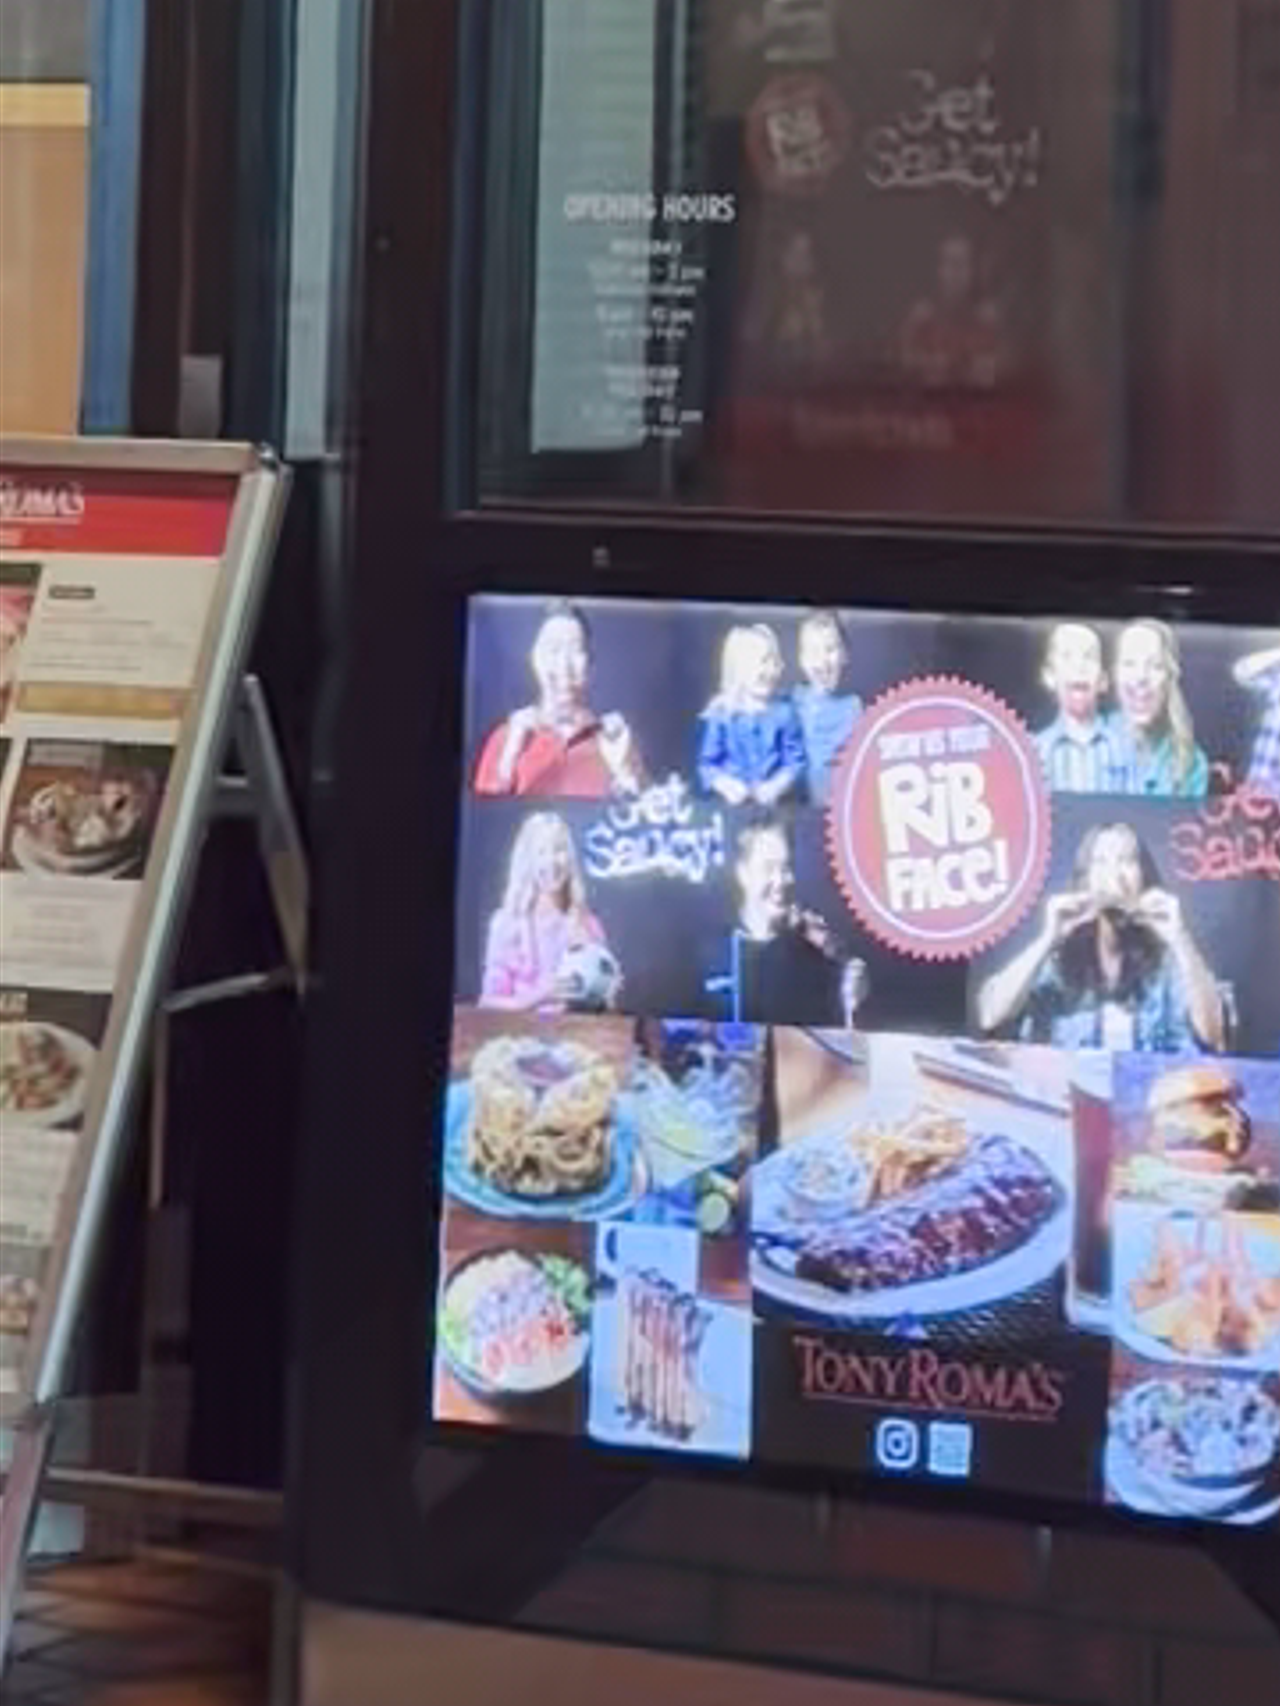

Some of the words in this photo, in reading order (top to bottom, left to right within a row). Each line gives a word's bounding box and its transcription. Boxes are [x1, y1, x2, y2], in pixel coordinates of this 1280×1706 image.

[564, 193, 656, 221] OPENING
[662, 193, 735, 223] HOURS
[793, 1334, 906, 1396] TONY
[906, 1348, 1064, 1412] ROMA'S
